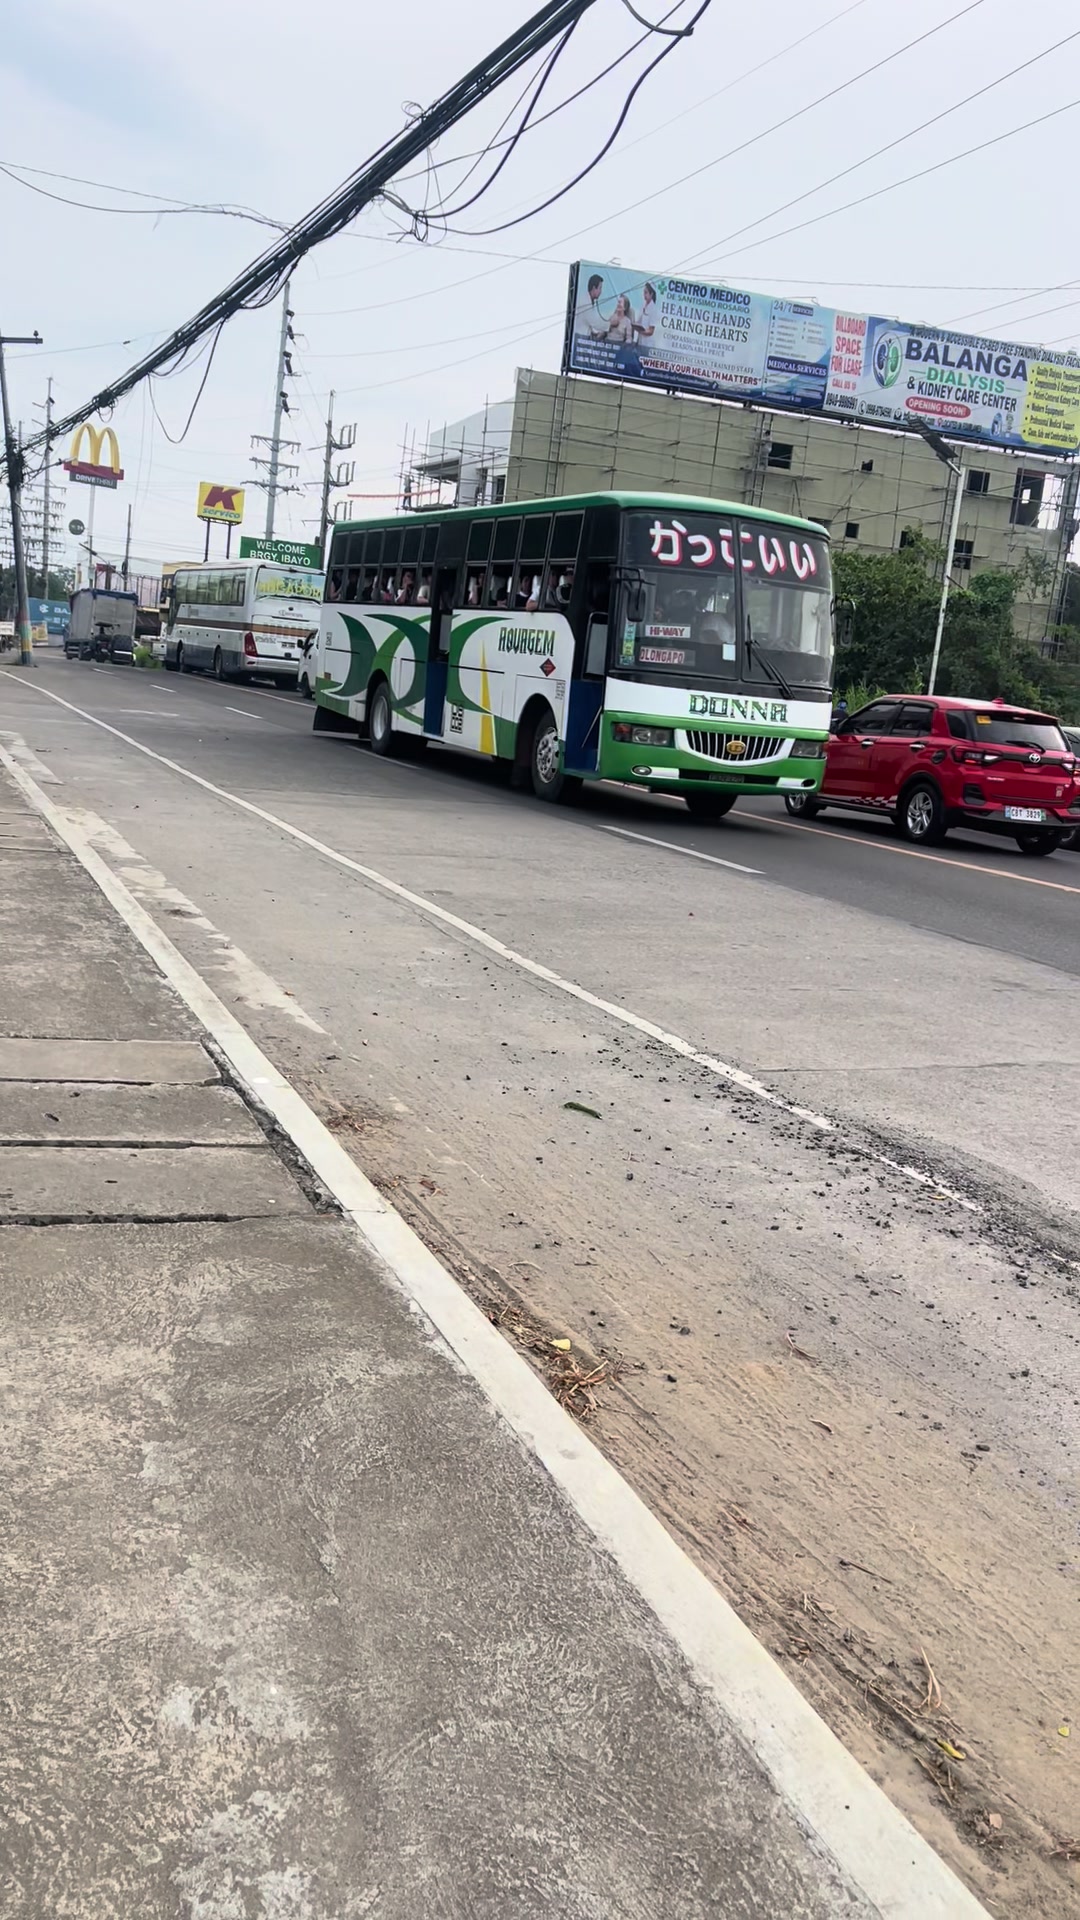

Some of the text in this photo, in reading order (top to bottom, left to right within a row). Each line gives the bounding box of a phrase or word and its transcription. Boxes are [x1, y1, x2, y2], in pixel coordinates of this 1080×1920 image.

[666, 292, 750, 314] DE SANTISIMO ROSARIO
[668, 280, 751, 306] CENTRO MEDICO
[661, 301, 752, 330] HEALING HANDS
[773, 300, 793, 313] 24/7
[661, 316, 748, 343] CARING HEARTS
[836, 315, 867, 336] BILLBOARD
[663, 332, 735, 352] COMPASSIONATE SERVICE
[835, 336, 862, 356] SPACE
[768, 359, 827, 376] MEDICAL SERVICES
[830, 355, 862, 376] FOR LEASE
[905, 338, 1028, 382] BALANGA
[671, 364, 691, 374] YOUR
[692, 368, 721, 379] HEALTH
[926, 367, 1005, 394] DIALYSIS
[907, 376, 1018, 412] & KIDNEY CARE CENTER
[908, 398, 942, 412] OPENING
[943, 403, 967, 416] SOON!
[75, 474, 95, 483] DRIVE
[203, 486, 242, 511] K
[249, 550, 311, 566] BRGY. IBAYO
[256, 540, 306, 555] WELCOME
[649, 519, 817, 580] かっこいい
[498, 627, 556, 657] AQUAGEM
[649, 626, 685, 637] HI-WAY
[640, 648, 684, 663] OLONGAPO
[689, 694, 789, 723] DONNA
